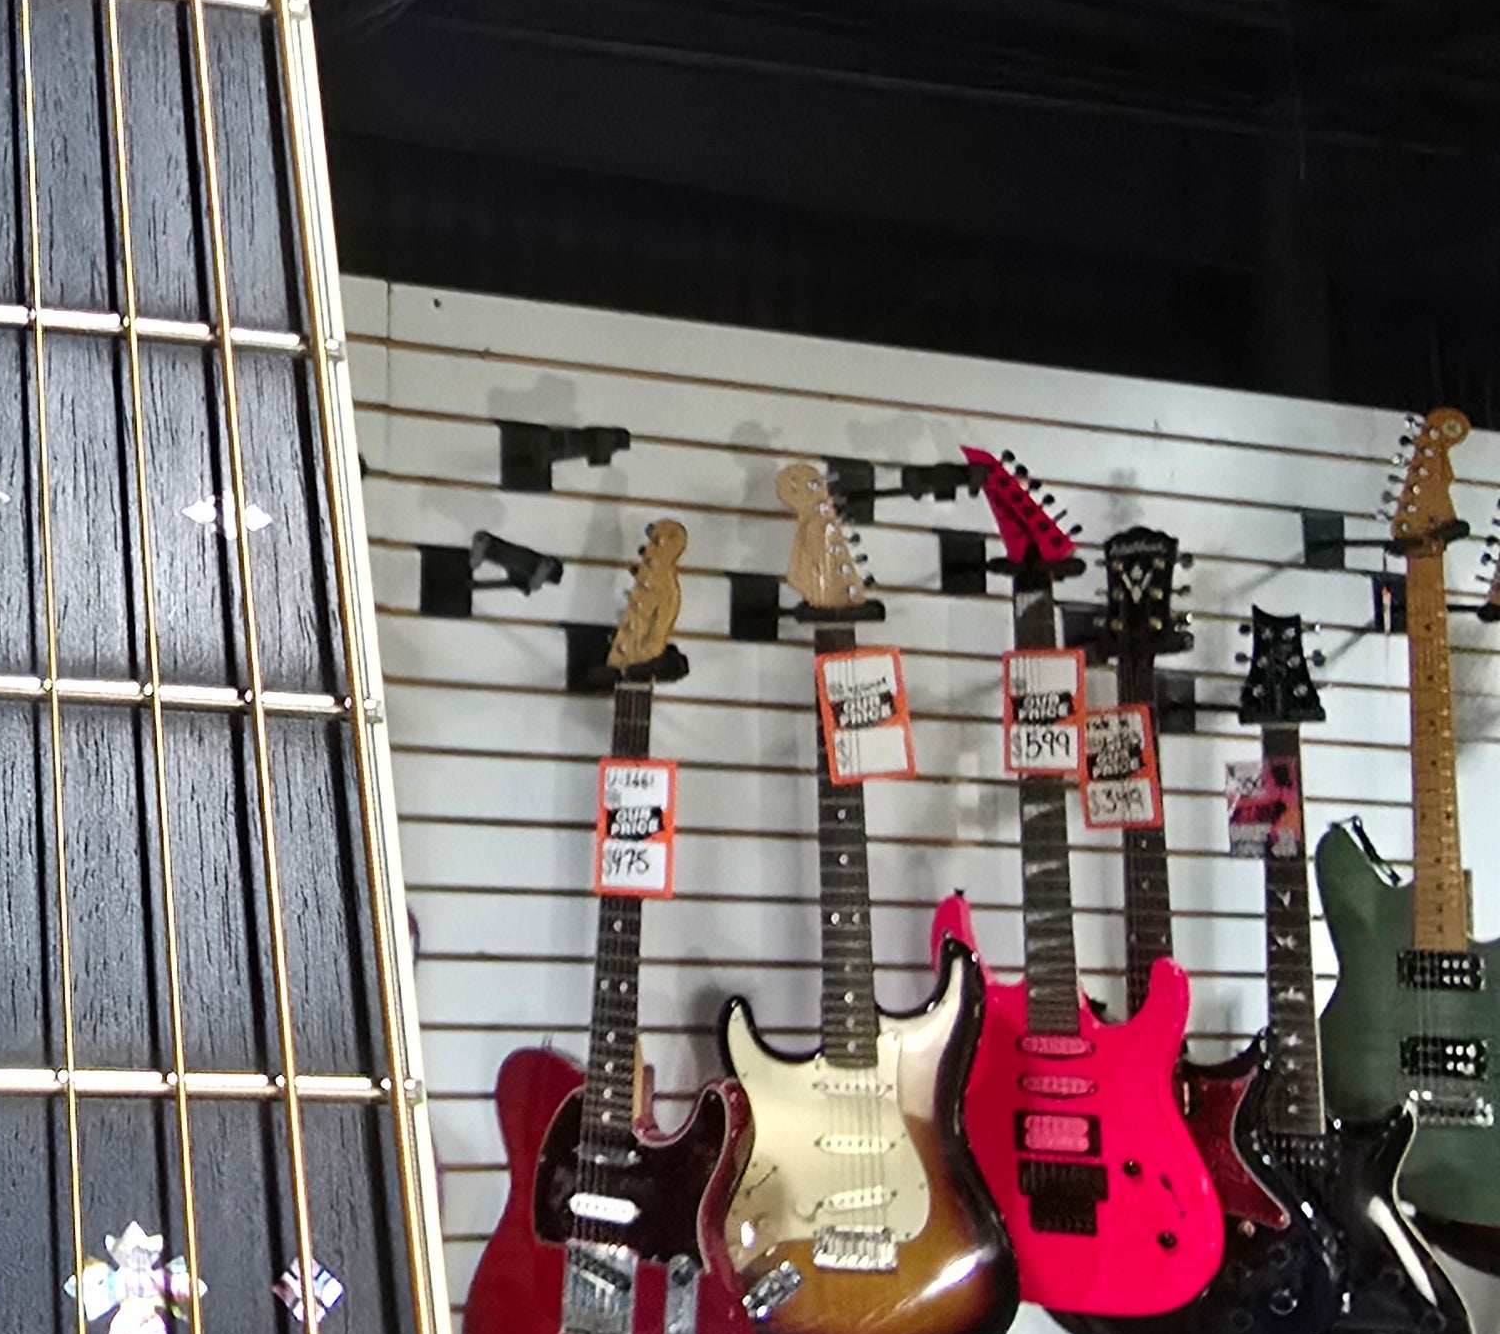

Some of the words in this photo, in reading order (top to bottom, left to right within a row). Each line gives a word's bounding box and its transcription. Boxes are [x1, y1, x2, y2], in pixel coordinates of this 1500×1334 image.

[1010, 729, 1071, 760] $599
[610, 816, 660, 836] PRICE
[615, 807, 651, 824] OUR
[603, 848, 649, 876] $475
